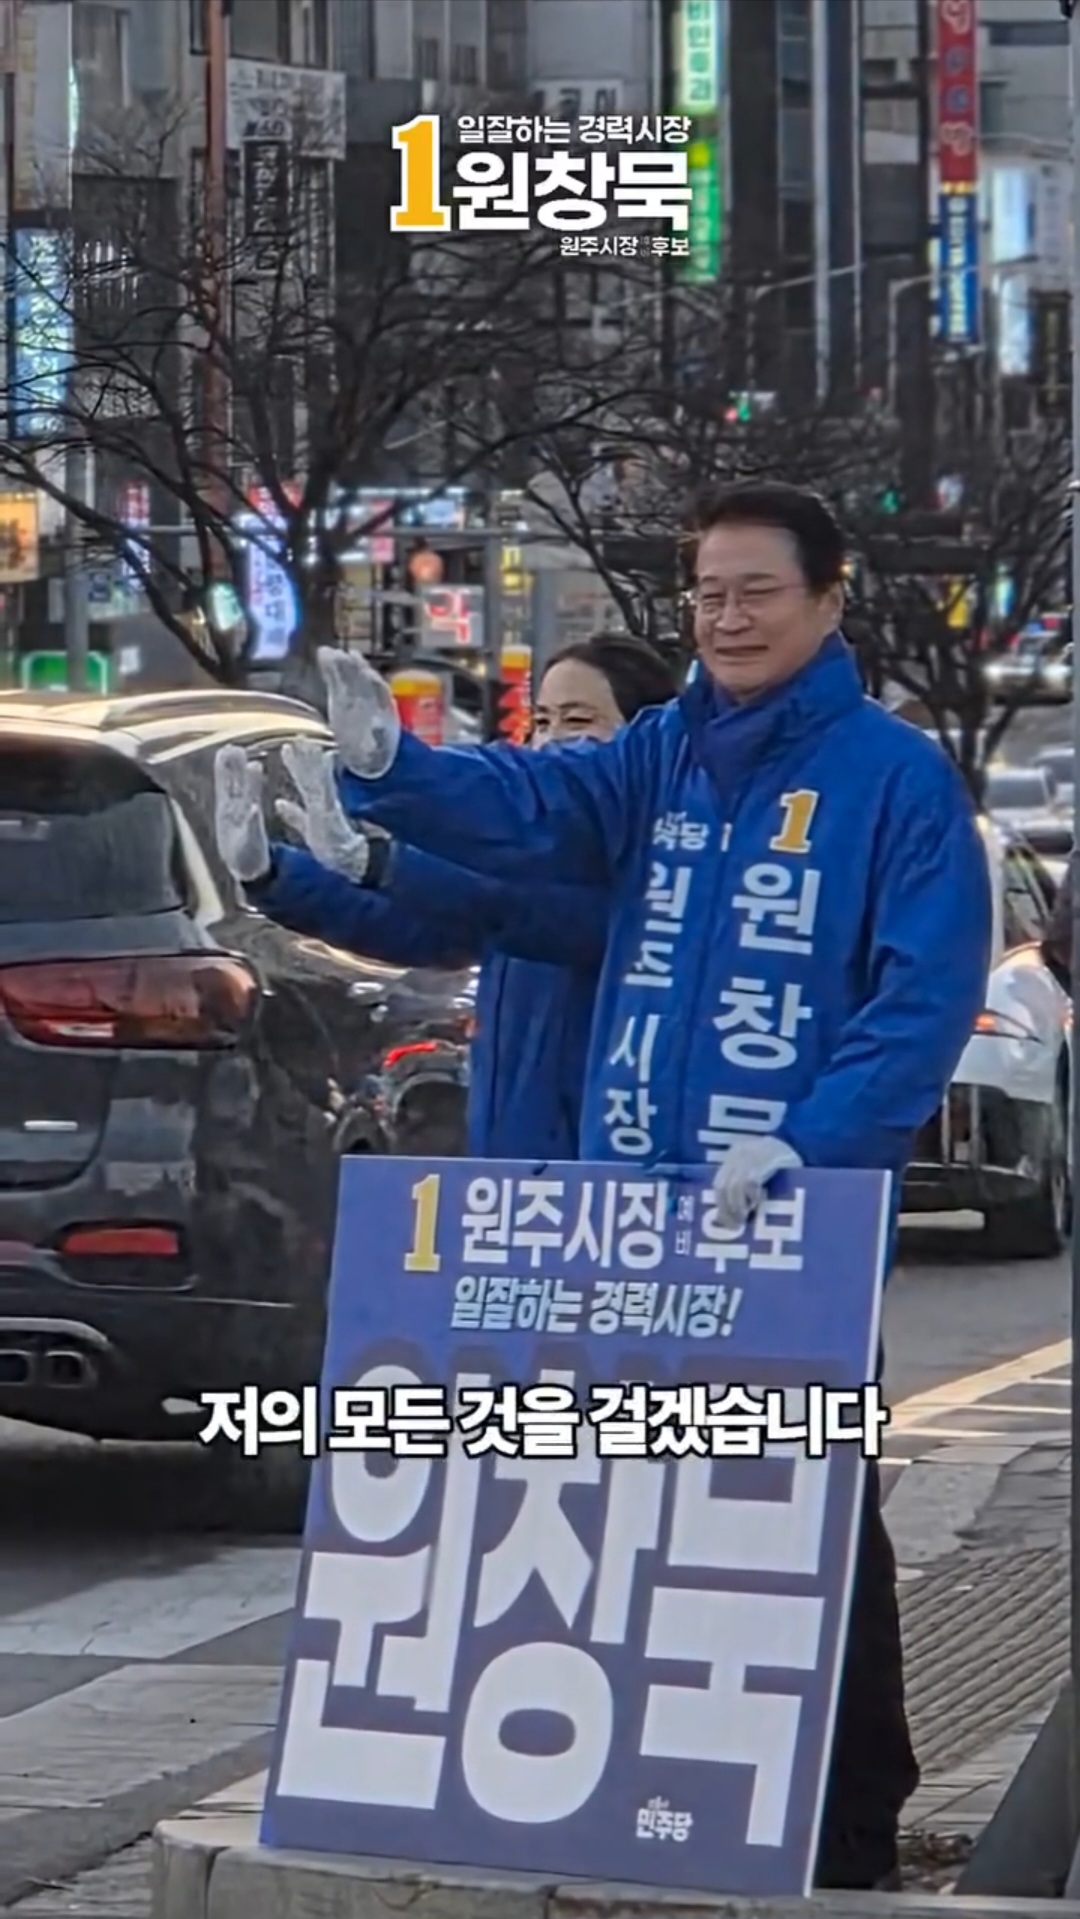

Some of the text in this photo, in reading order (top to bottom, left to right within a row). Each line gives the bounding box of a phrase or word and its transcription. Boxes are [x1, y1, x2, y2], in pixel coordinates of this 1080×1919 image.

[769, 789, 820, 854] 1
[404, 1173, 441, 1272] 1
[461, 1176, 668, 1270] 원주시장
[695, 1187, 806, 1274] 후보
[450, 1275, 743, 1338] 일잘하는 경력시장!
[637, 1808, 693, 1842] 민주당
